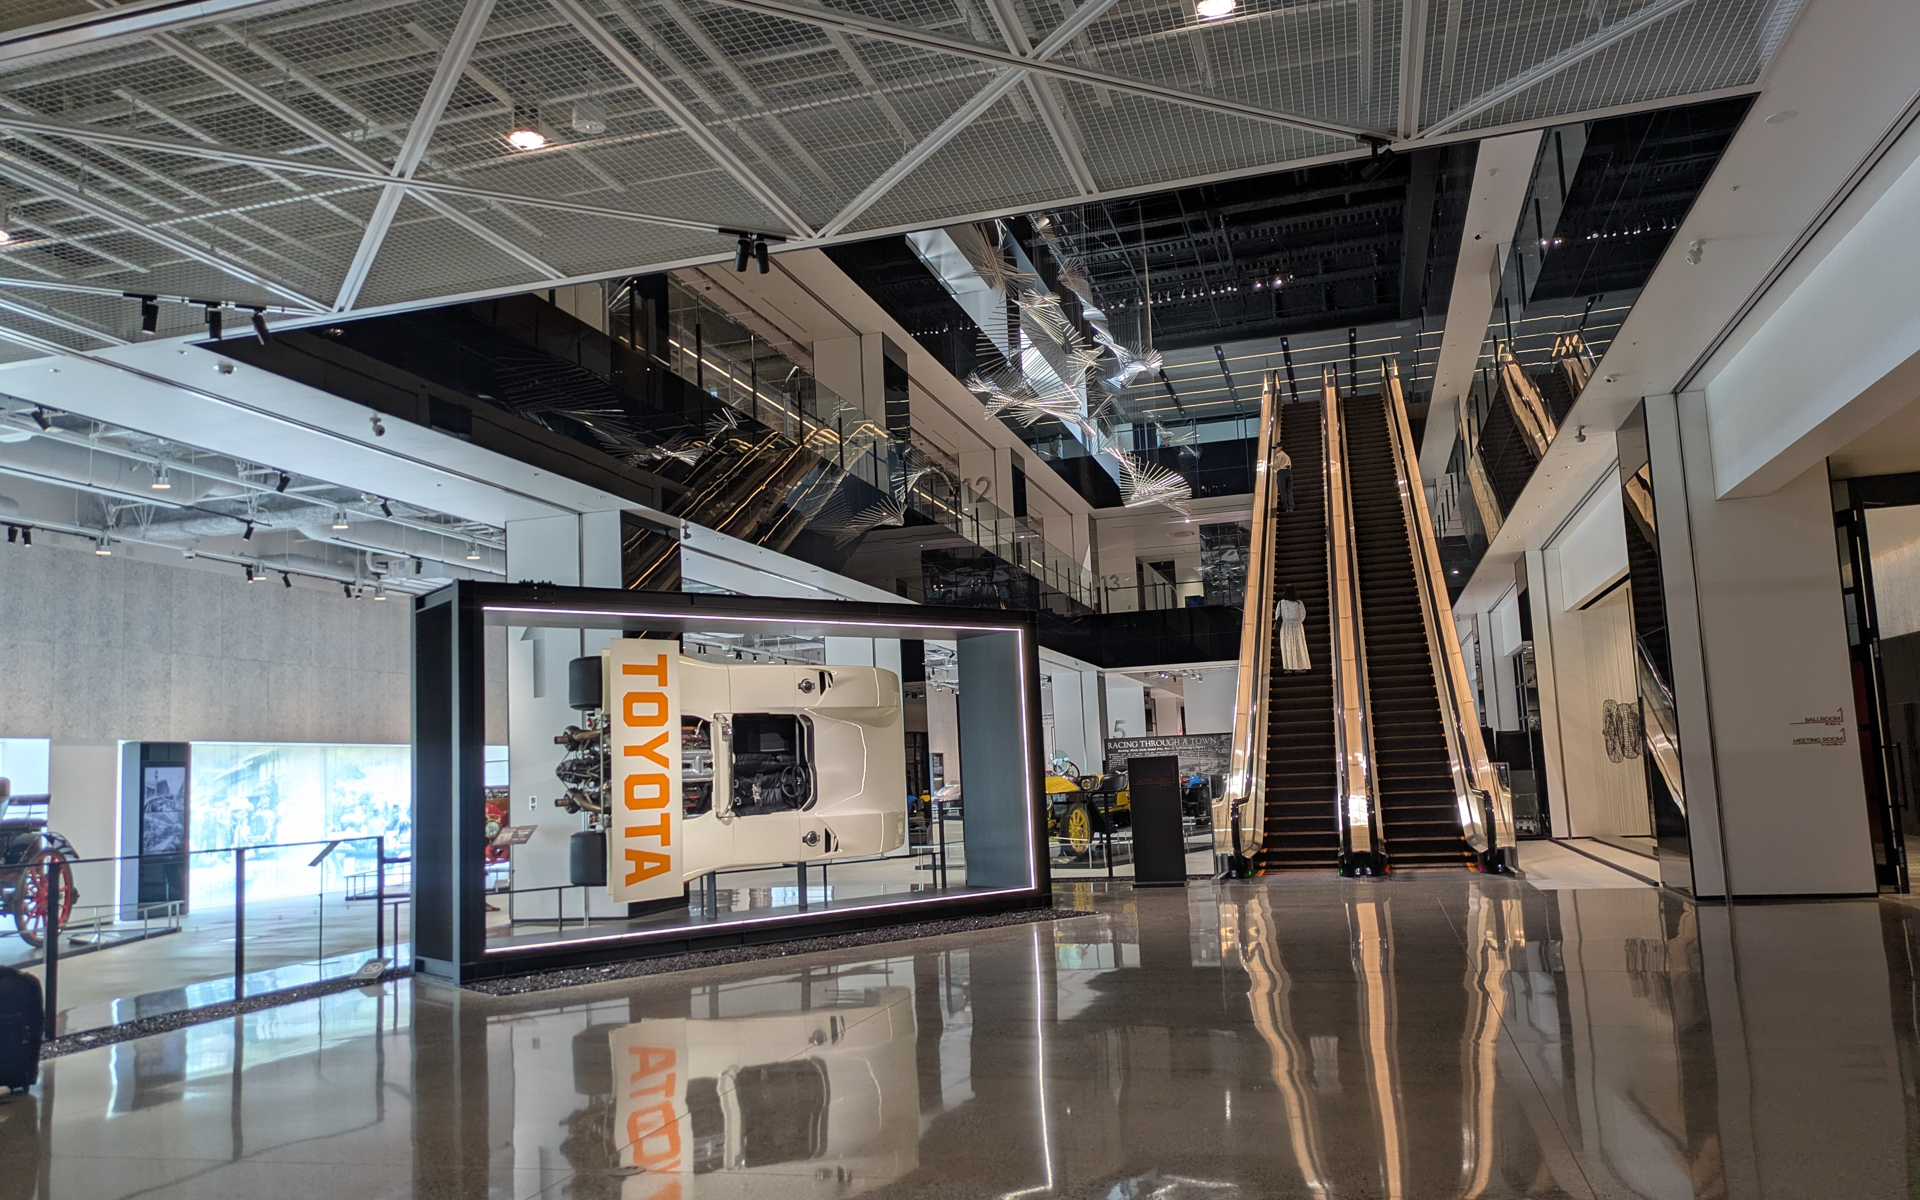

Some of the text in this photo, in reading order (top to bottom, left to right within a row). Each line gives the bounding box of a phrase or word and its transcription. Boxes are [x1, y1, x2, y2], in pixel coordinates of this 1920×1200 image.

[963, 476, 992, 504] 12
[1100, 574, 1120, 592] 13
[1113, 720, 1126, 738] 5
[1108, 741, 1138, 749] RACING
[1140, 738, 1180, 747] THROUGH
[1190, 736, 1217, 744] TOWN
[622, 654, 671, 887] TOYOTA
